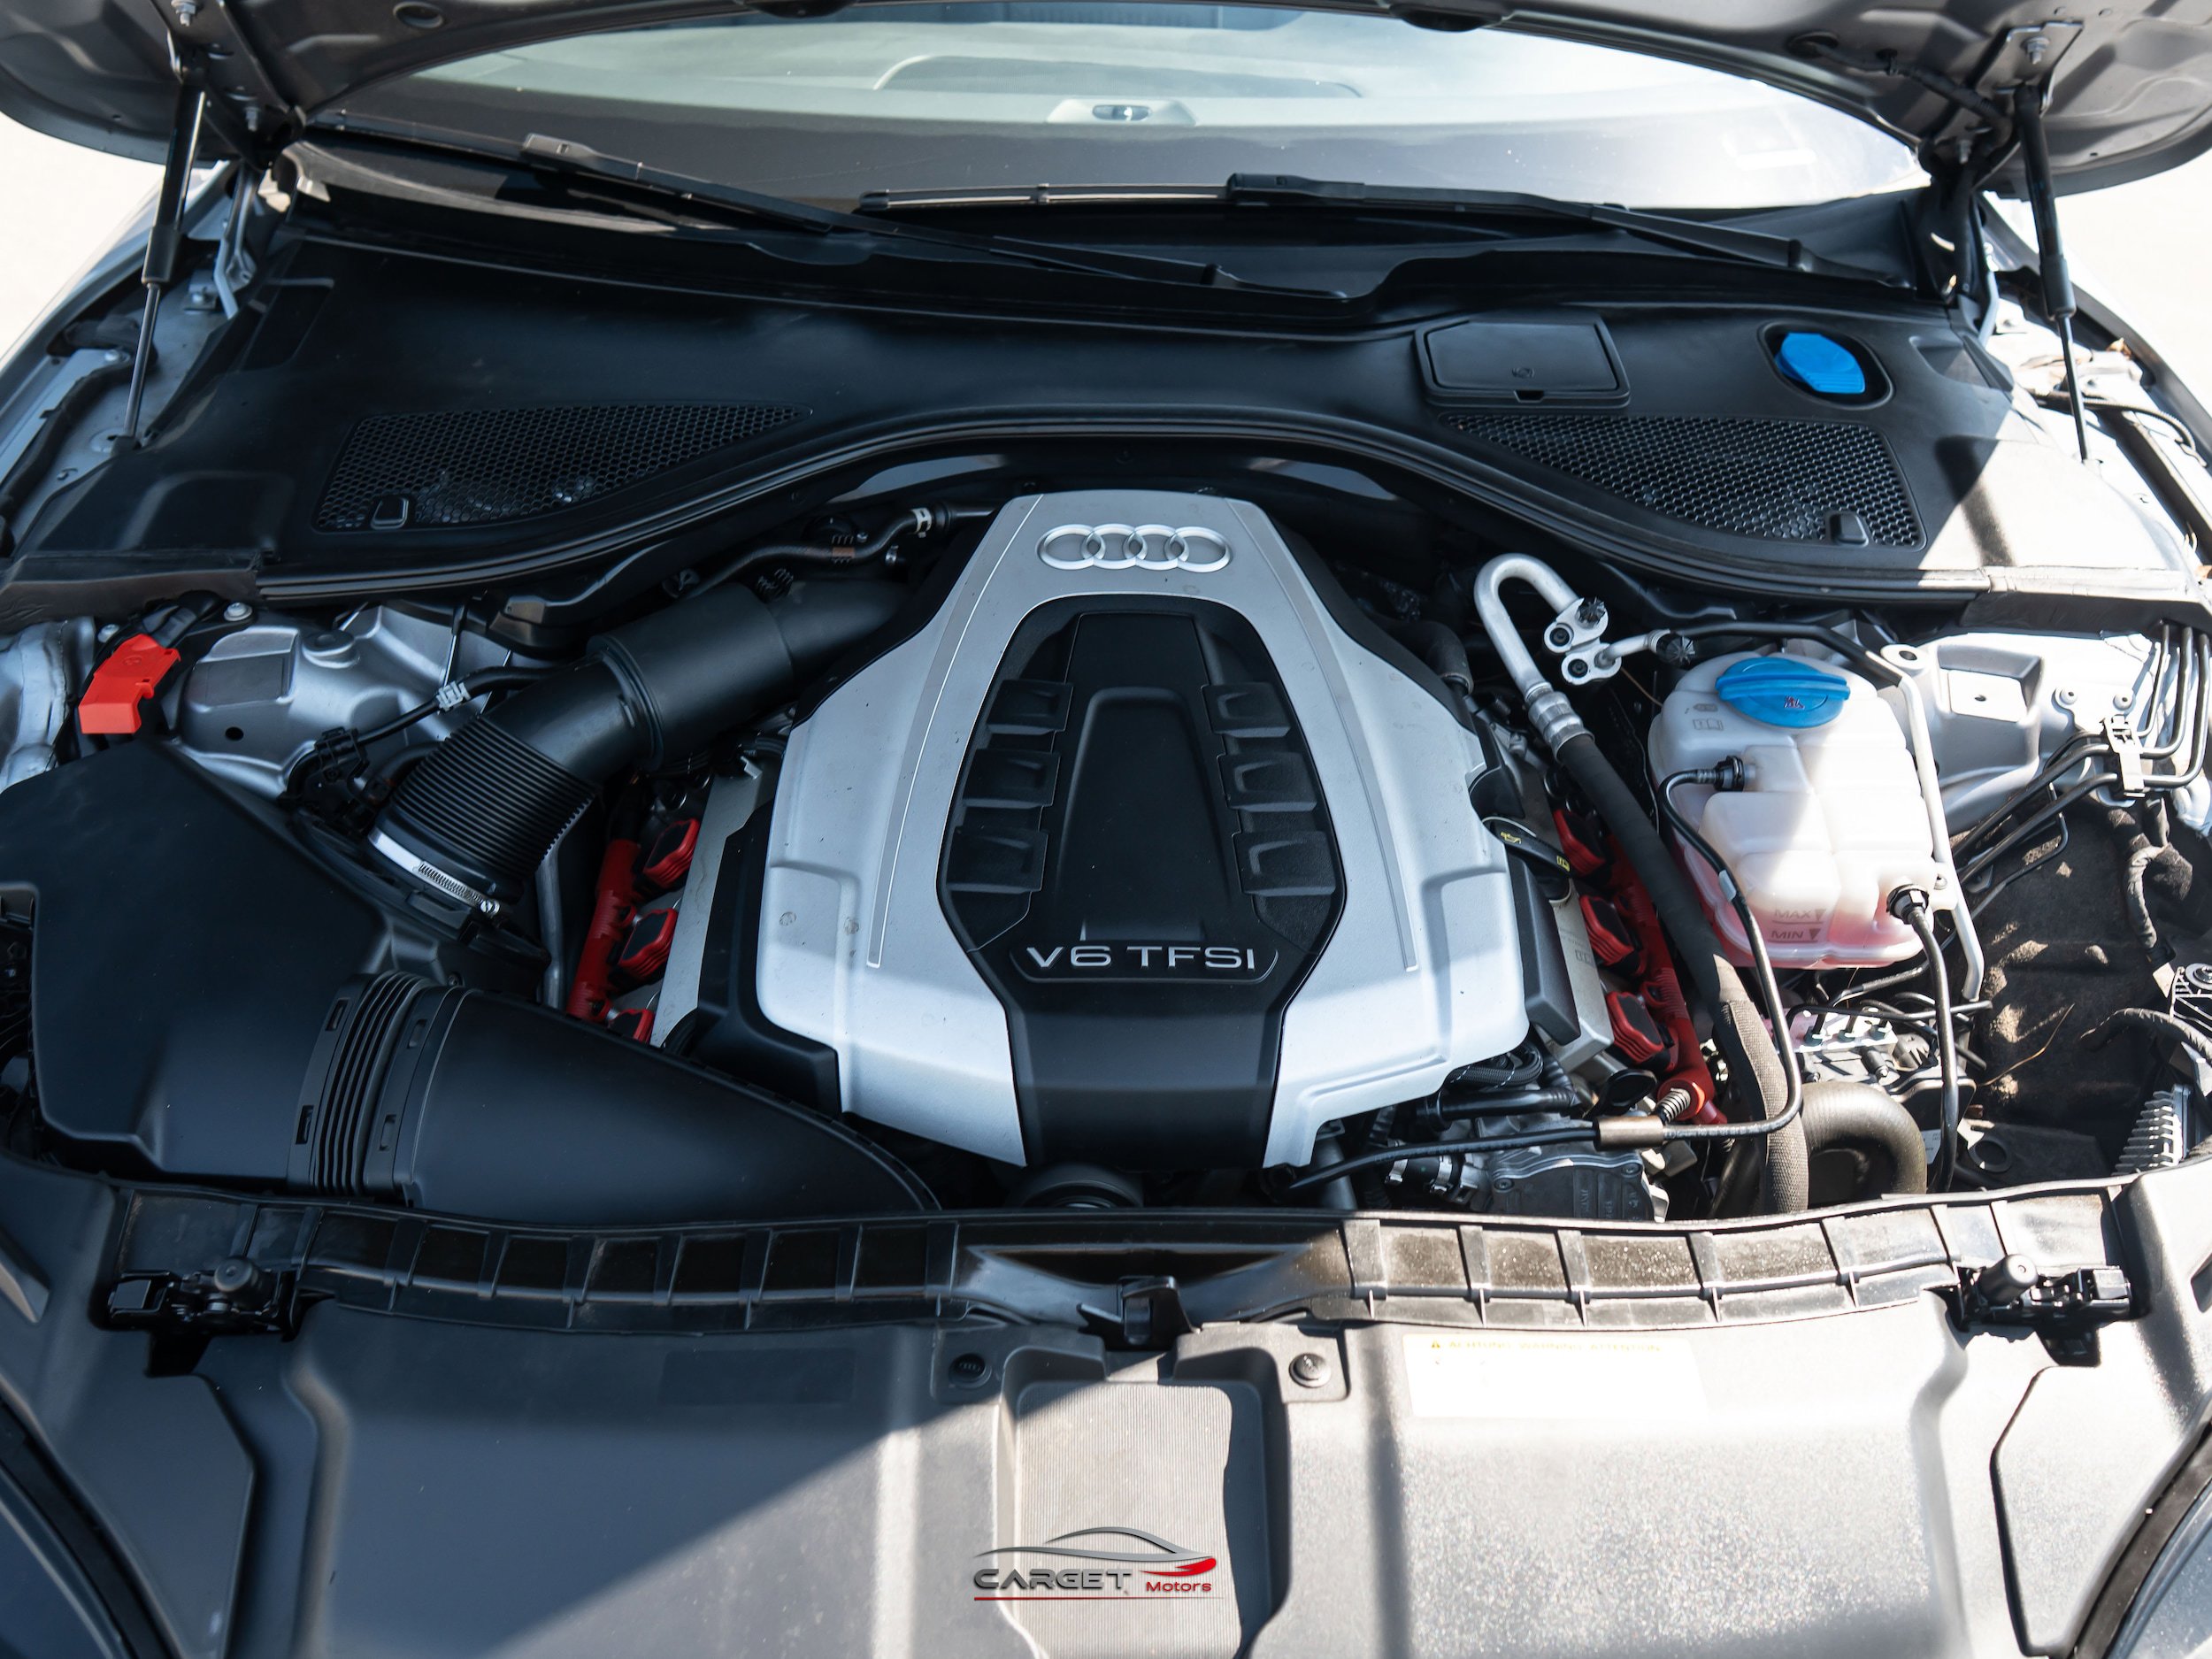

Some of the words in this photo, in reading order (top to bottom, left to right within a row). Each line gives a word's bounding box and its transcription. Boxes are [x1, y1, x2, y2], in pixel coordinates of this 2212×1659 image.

[1774, 909, 1812, 919] MAX
[1770, 931, 1805, 940] MIN
[1026, 945, 1112, 969] V6
[1126, 946, 1256, 970] TFSI
